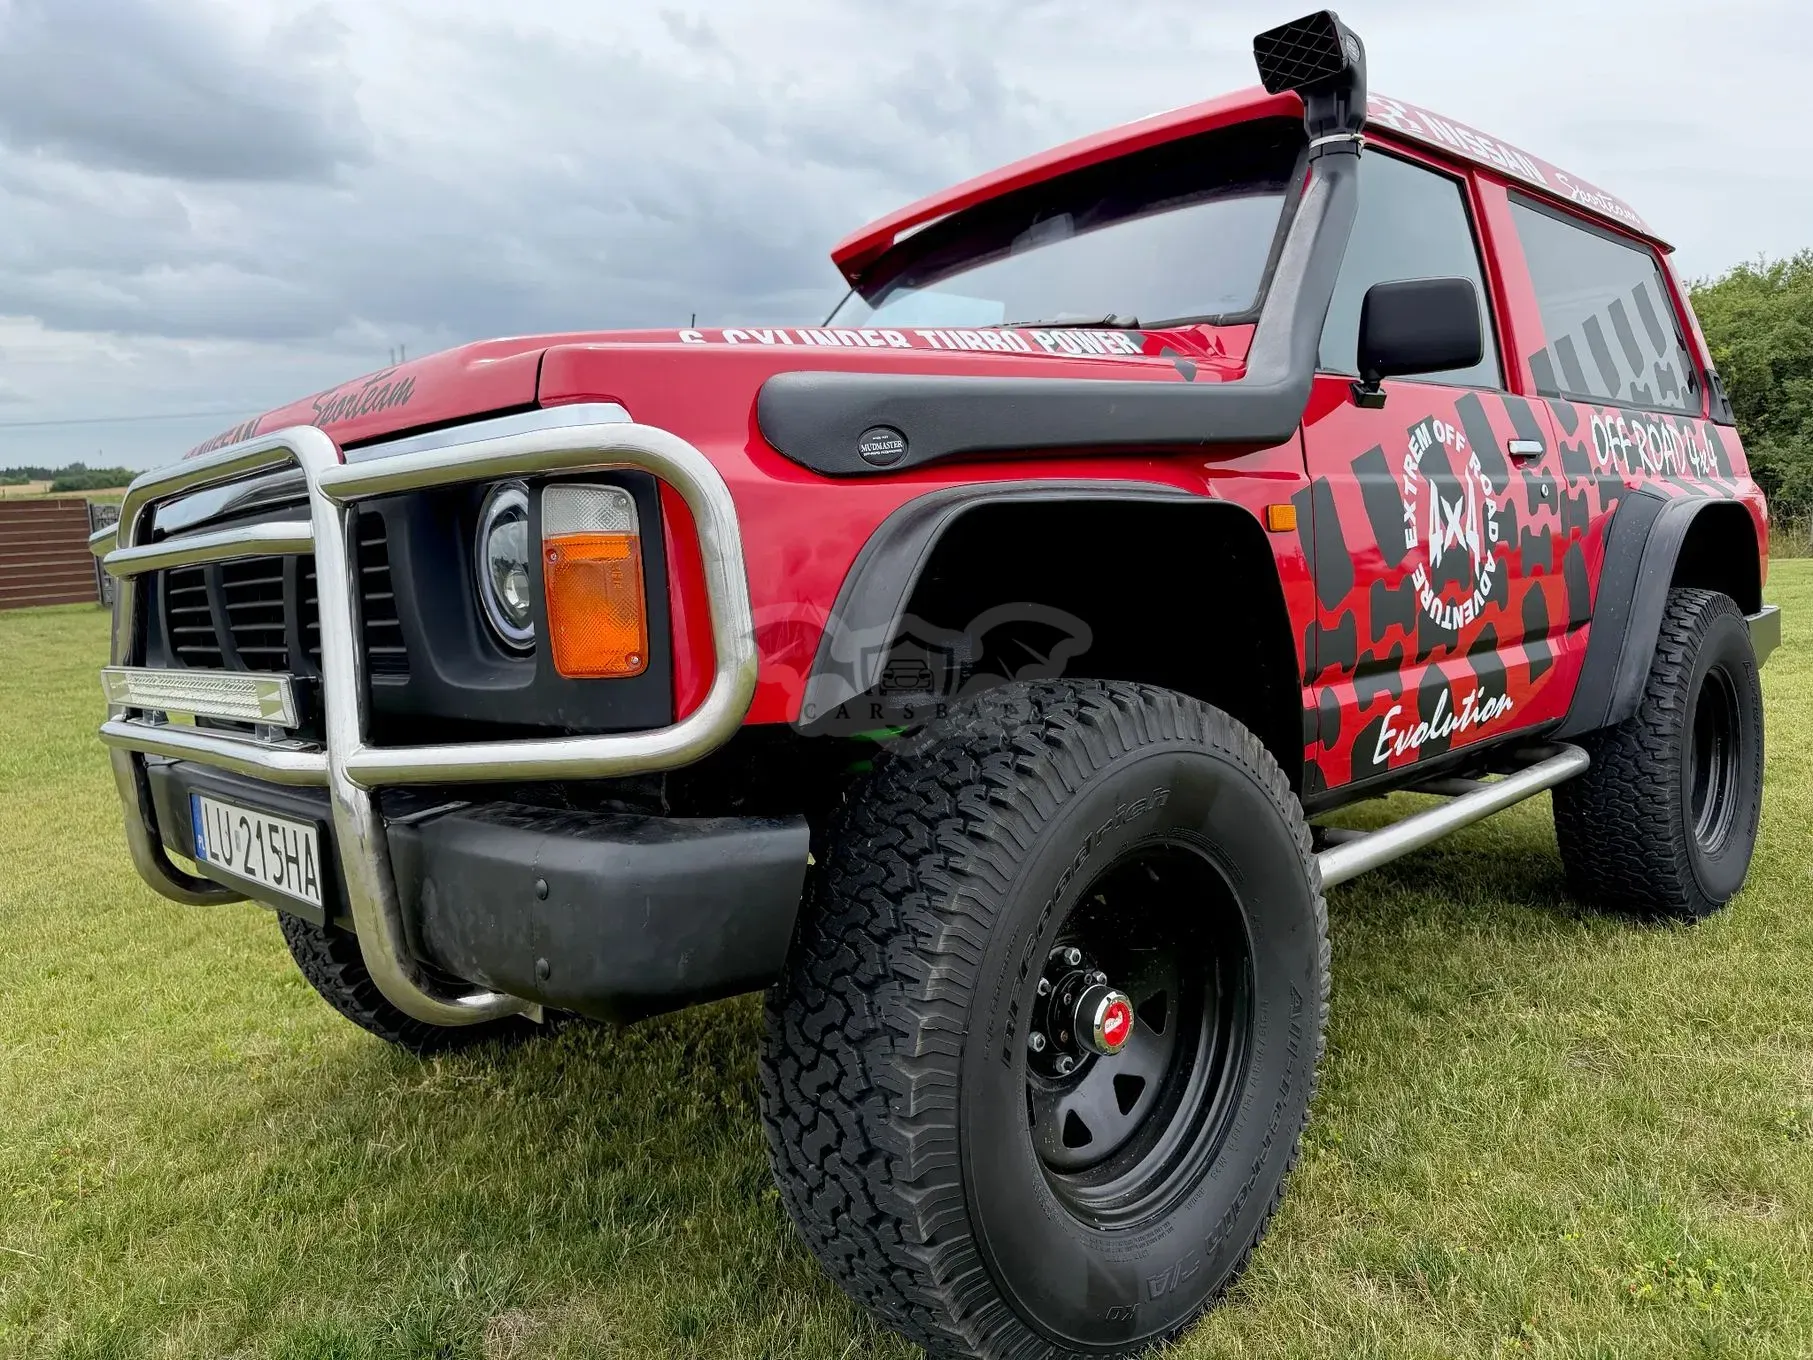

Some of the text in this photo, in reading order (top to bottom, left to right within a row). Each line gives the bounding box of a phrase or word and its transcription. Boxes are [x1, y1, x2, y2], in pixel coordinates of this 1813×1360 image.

[1414, 110, 1547, 184] NISSAN
[916, 331, 1032, 352] TURBO
[1029, 332, 1143, 354] POWER
[860, 440, 903, 453] MUDMASTER
[1590, 415, 1632, 472] OFF
[1631, 420, 1685, 475] ROAD
[1403, 419, 1499, 631] EXTREM OFF ROAD ADVENTURE
[1372, 686, 1514, 765] Evolution
[204, 803, 320, 901] LU 215HA
